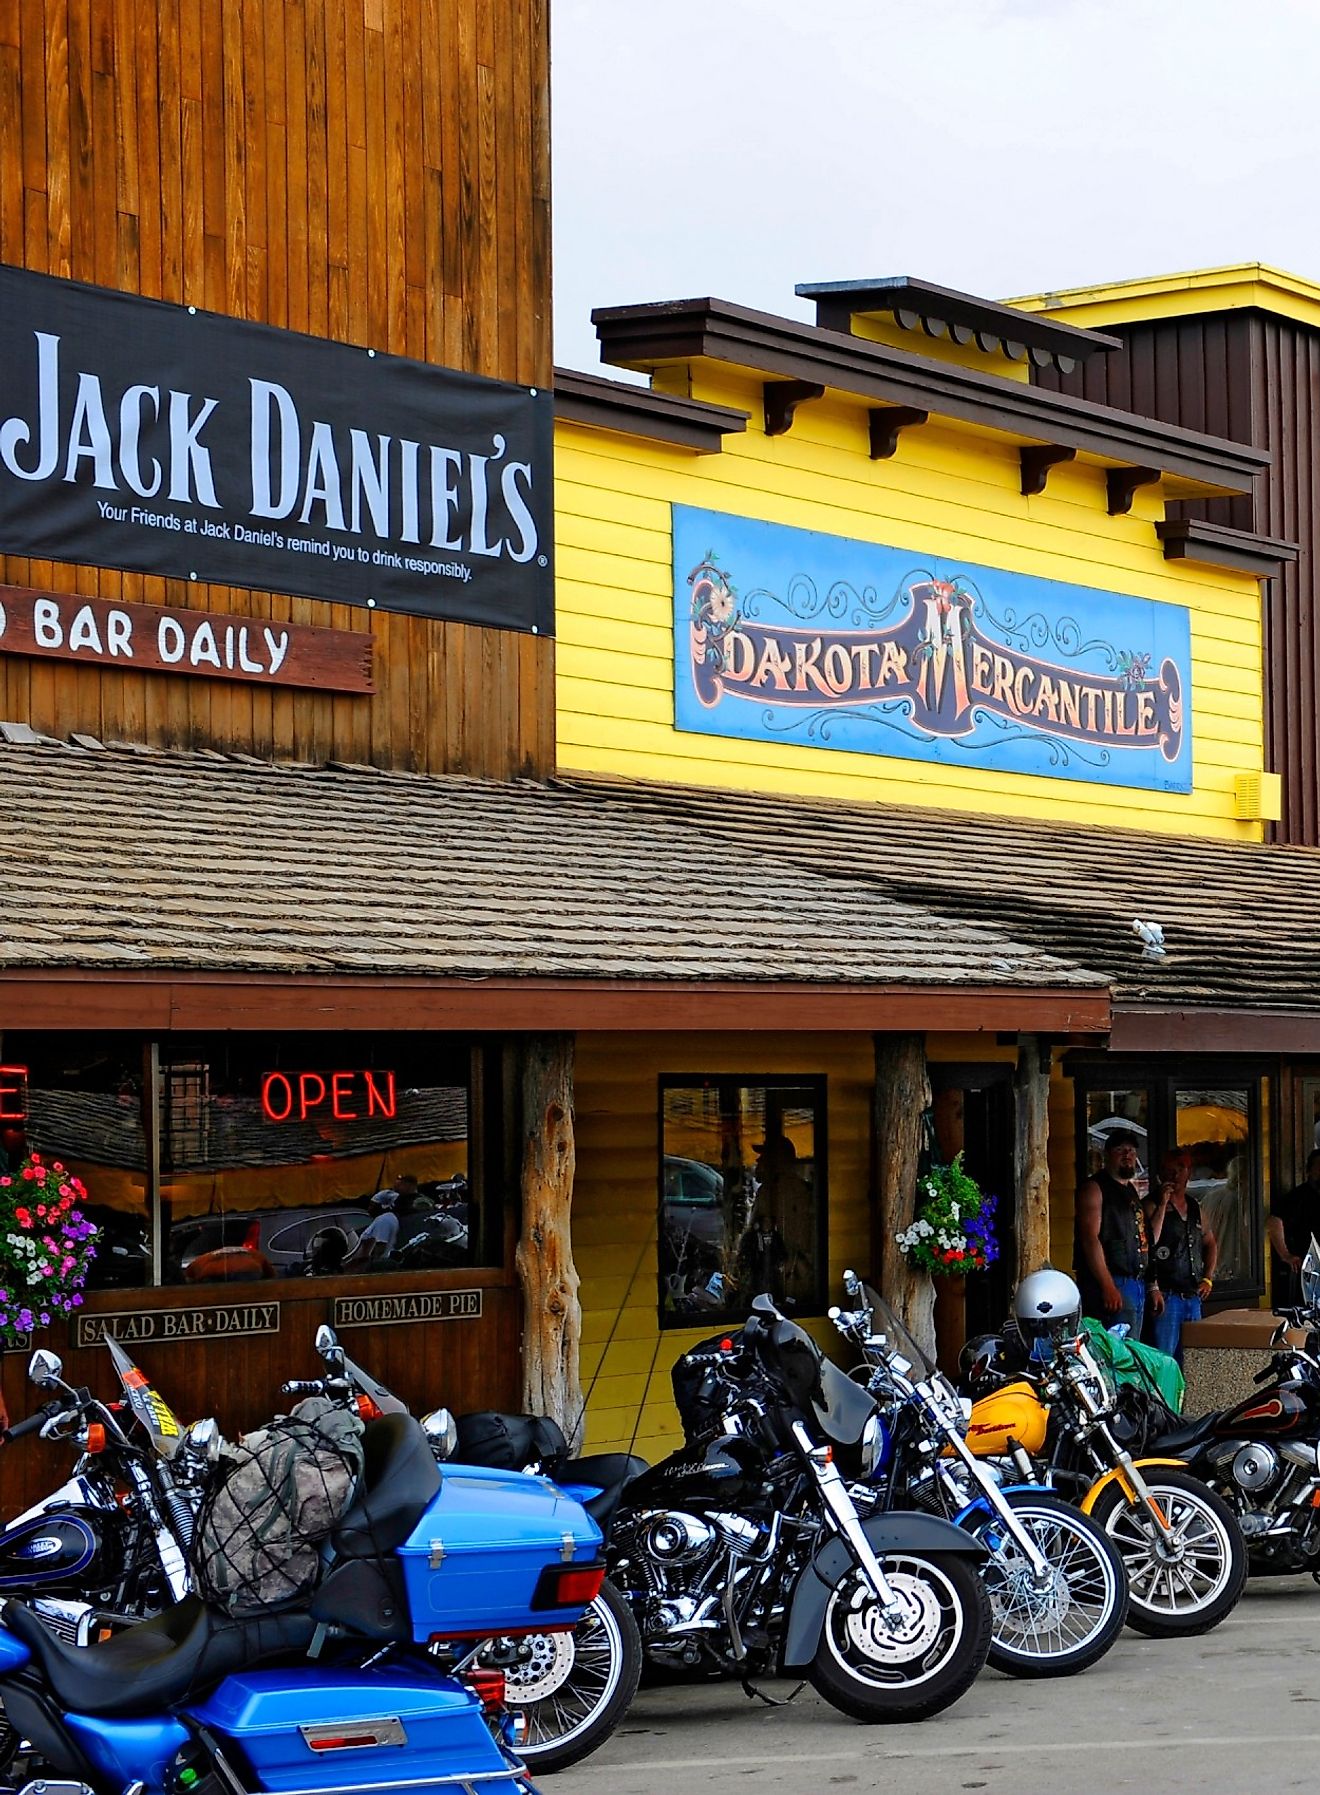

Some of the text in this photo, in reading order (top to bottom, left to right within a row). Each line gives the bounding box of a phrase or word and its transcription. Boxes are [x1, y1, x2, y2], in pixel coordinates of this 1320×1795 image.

[0, 331, 538, 563] JACK DANIEL'S
[97, 501, 473, 583] Your Friends at Jack Daniel's remind you to drink responsibly.
[33, 598, 135, 657] BAR
[157, 616, 289, 676] DAILY
[723, 599, 1162, 737] DAKOTA MERCANTILE
[262, 1072, 397, 1121] OPEN
[84, 1316, 156, 1342] SALAD
[341, 1294, 478, 1322] HOMEMADE PIE
